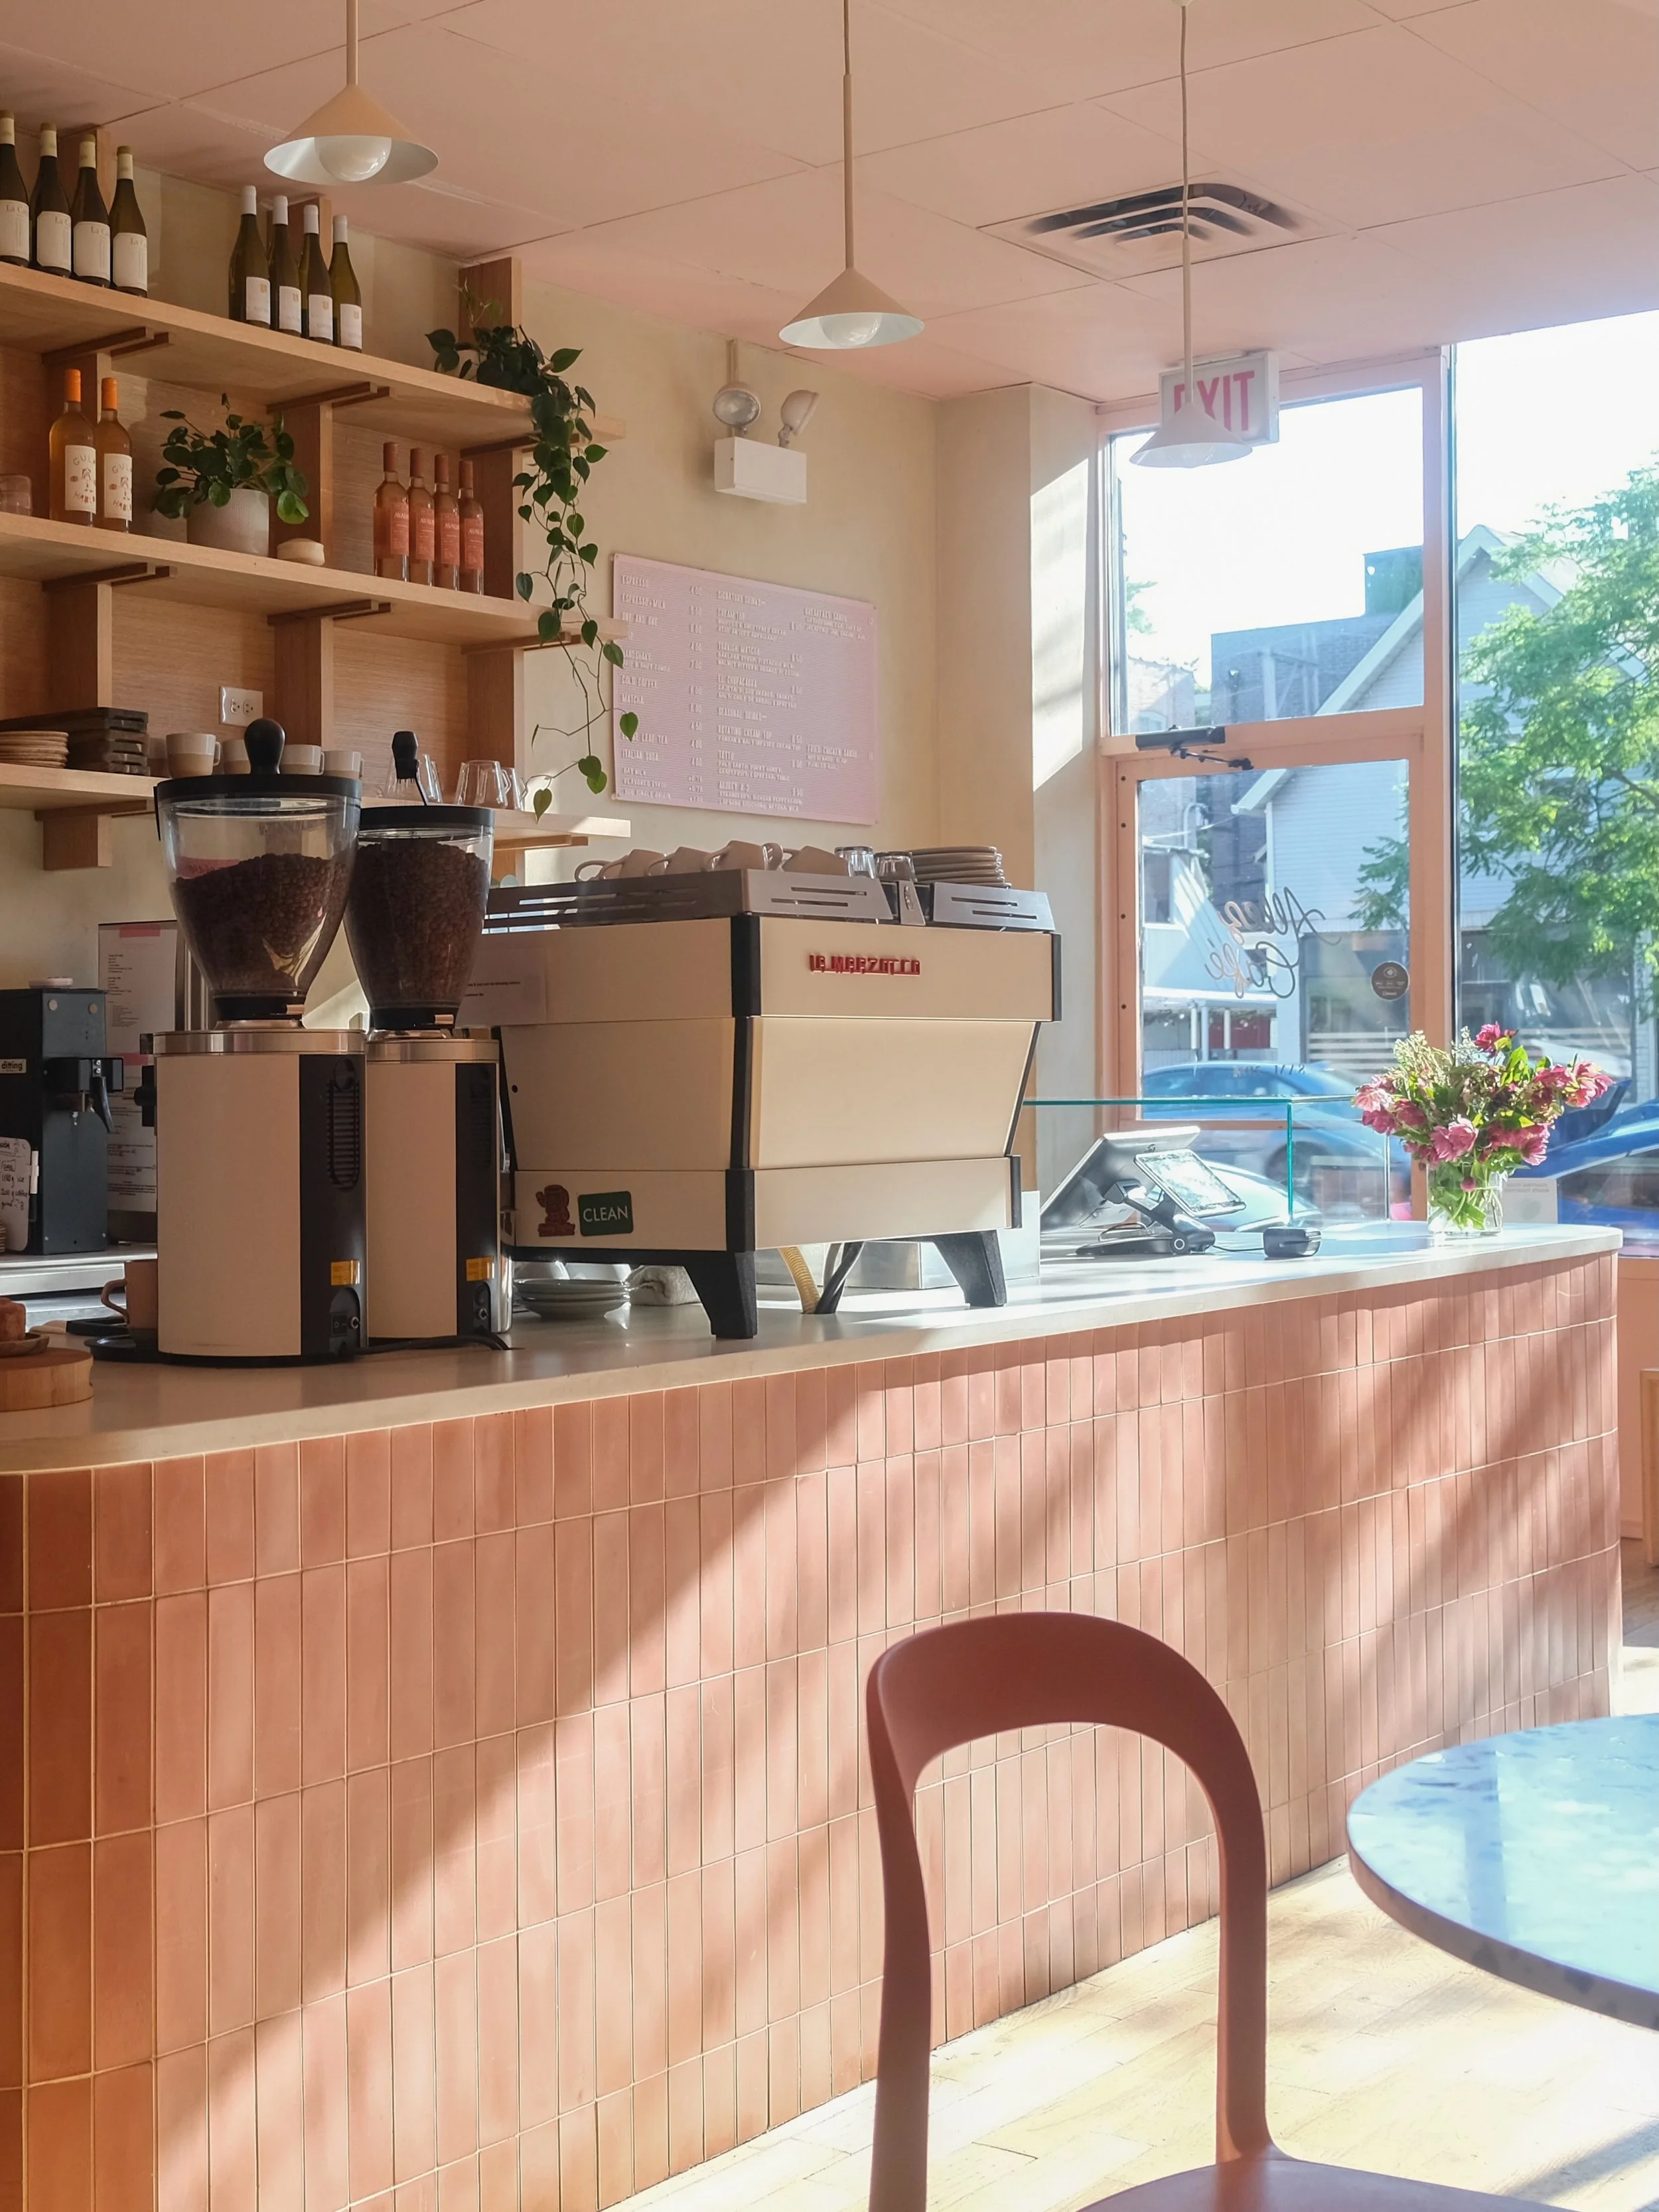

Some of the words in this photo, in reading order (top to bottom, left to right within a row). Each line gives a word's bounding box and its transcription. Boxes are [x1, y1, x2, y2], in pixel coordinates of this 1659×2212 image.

[1174, 370, 1255, 431] XIT
[622, 574, 648, 587] ESPRESSO
[717, 591, 743, 603] SIGNATURE
[622, 611, 631, 622] ONE
[635, 613, 645, 624] AND
[648, 615, 658, 627] ONE
[717, 608, 735, 619] CREAM
[804, 607, 830, 619] BREAKFAST
[833, 613, 847, 622] SANDO
[718, 642, 737, 652] TURKISH
[740, 645, 759, 655] MATCHA
[625, 649, 650, 661] ANDSHAKE
[622, 675, 635, 685] COLD
[638, 678, 657, 688] COFFEE
[621, 694, 644, 704] MATCHA
[718, 707, 742, 717] SEASONAL
[717, 725, 740, 735] ROTATING
[743, 728, 760, 737] CREAM
[762, 730, 772, 740] TOP
[641, 733, 654, 742] LEAF
[658, 734, 667, 745] TEA
[622, 749, 642, 759] ITALIAN
[645, 751, 658, 761] SODA
[822, 746, 840, 755] CHICKEN
[1, 1061, 23, 1071] ditting
[583, 1205, 629, 1222] CLEAN
